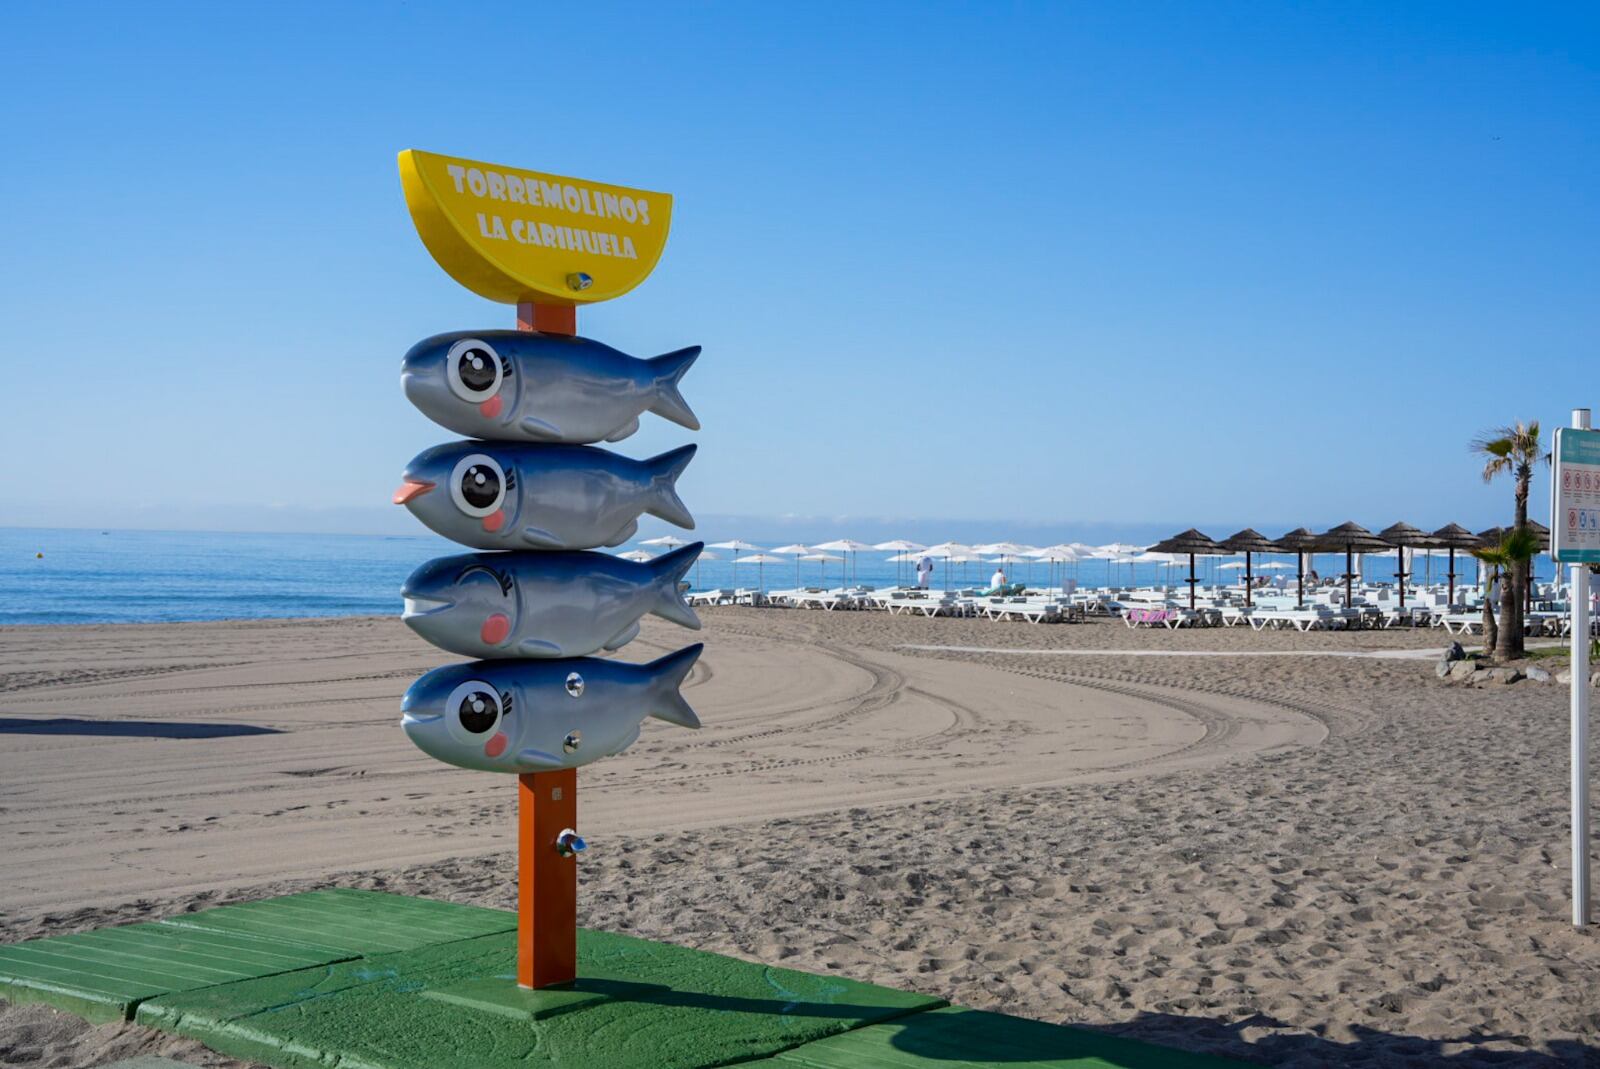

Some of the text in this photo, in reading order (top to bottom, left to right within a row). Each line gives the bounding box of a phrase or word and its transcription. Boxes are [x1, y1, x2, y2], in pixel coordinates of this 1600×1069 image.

[447, 165, 650, 225] TORREMOLINOS
[477, 213, 638, 259] LA CARIHUELA
